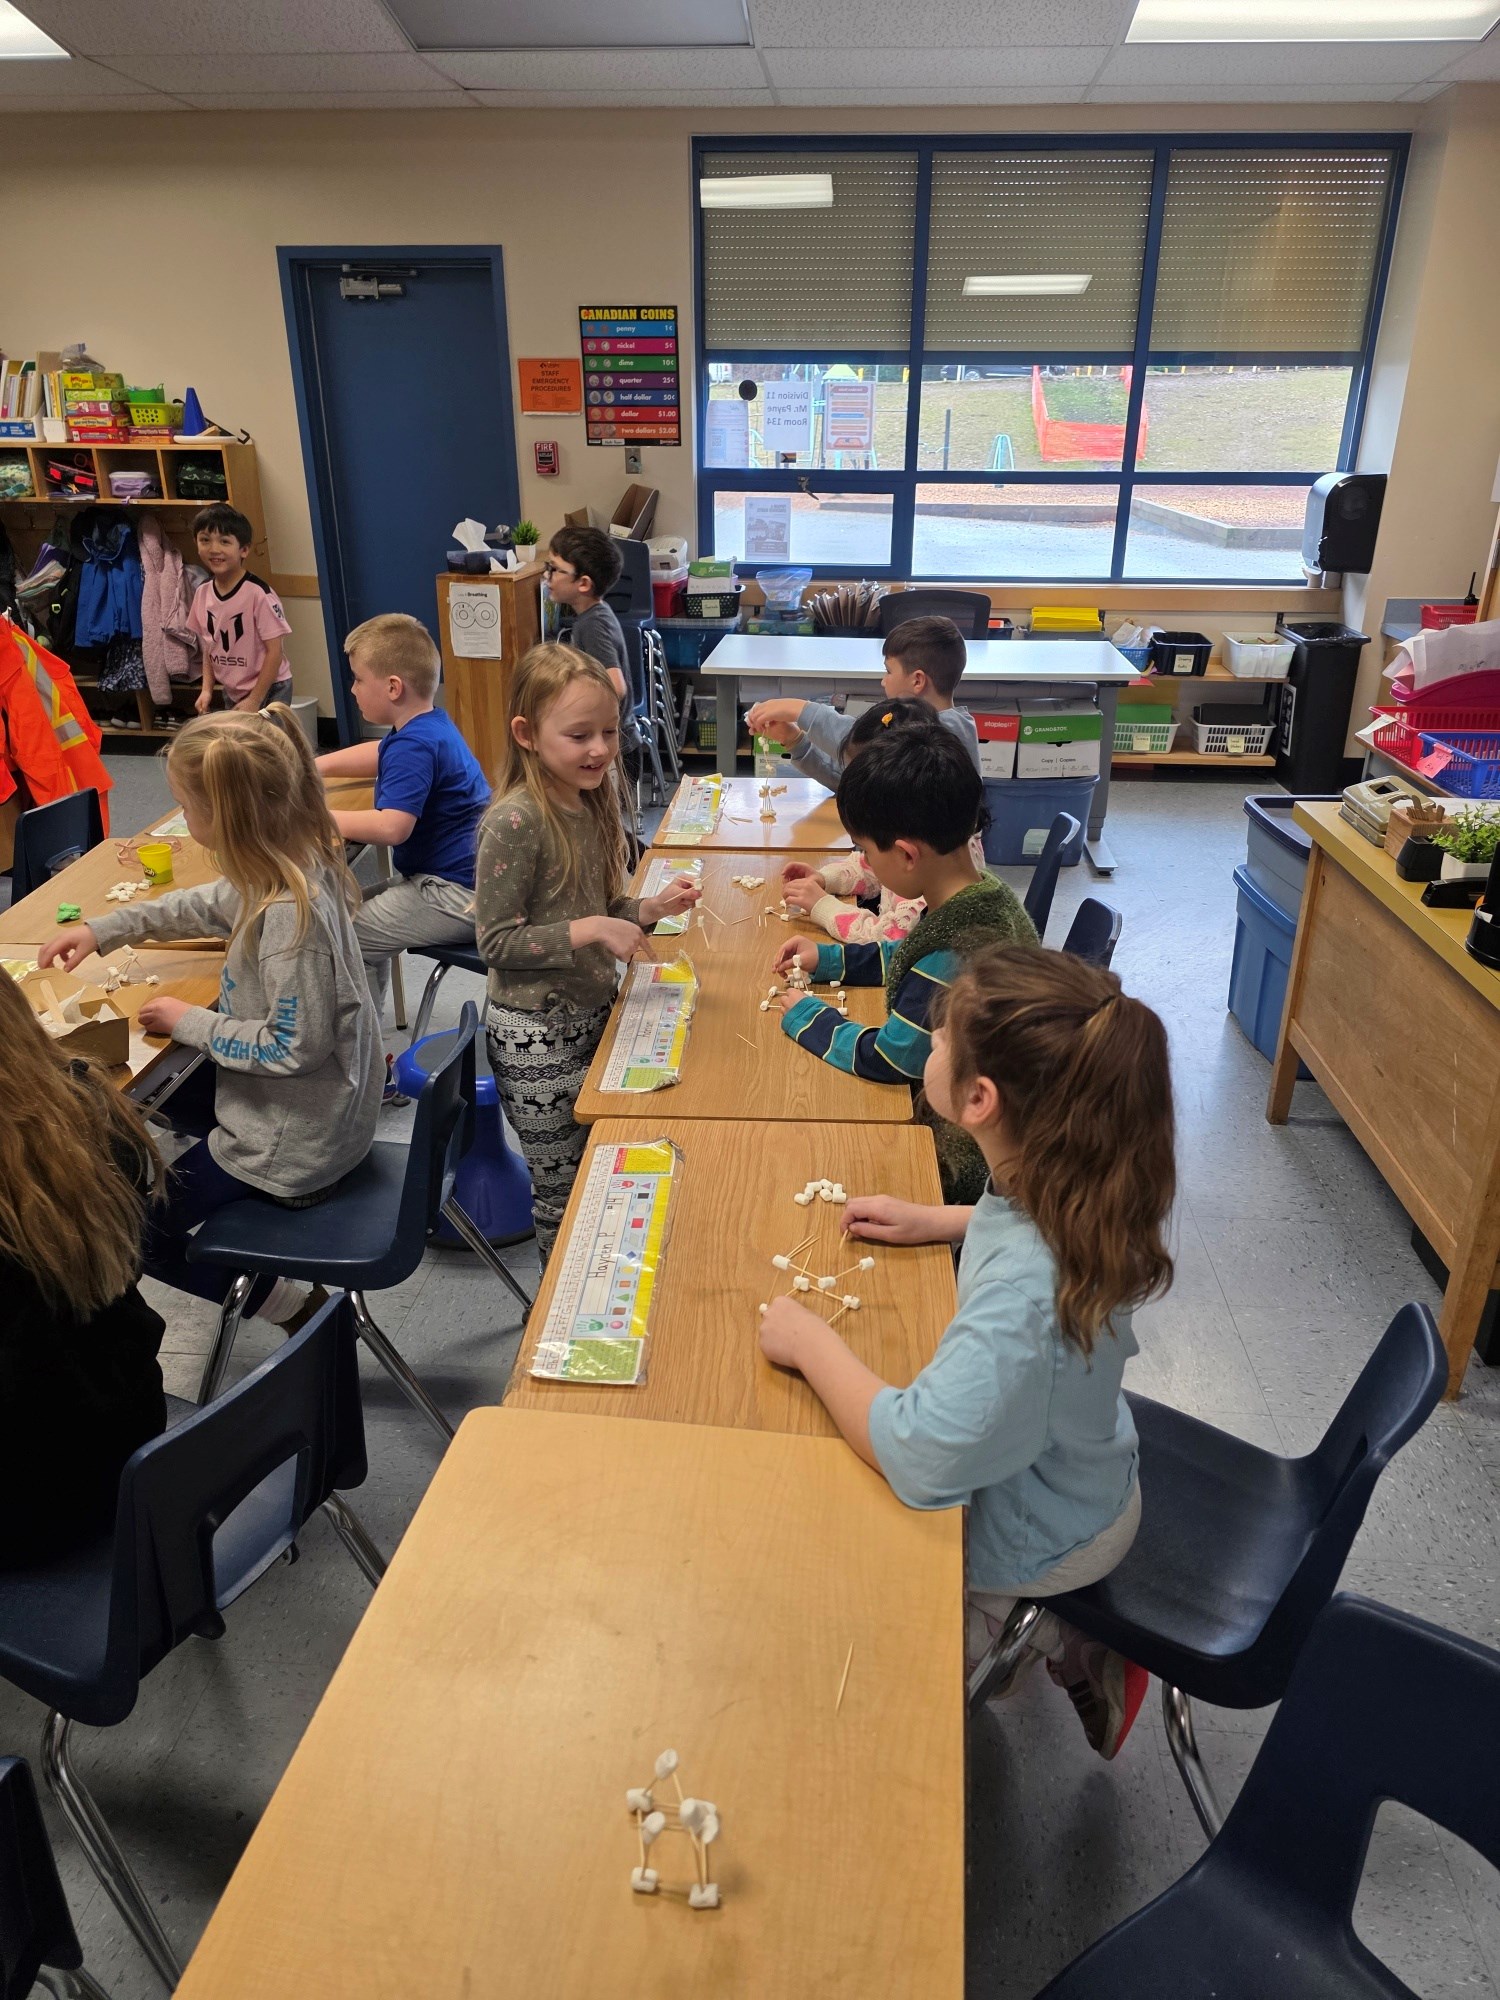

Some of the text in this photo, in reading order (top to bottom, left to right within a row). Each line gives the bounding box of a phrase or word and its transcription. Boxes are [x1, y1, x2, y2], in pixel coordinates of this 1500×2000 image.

[580, 308, 675, 320] CANADIAN COINS
[616, 325, 636, 333] penny
[616, 341, 635, 349] nickel
[618, 358, 634, 366] dime
[619, 377, 642, 385] quarter
[620, 393, 652, 401] half dollar
[620, 409, 639, 417] dollar
[536, 443, 553, 451] FIRE
